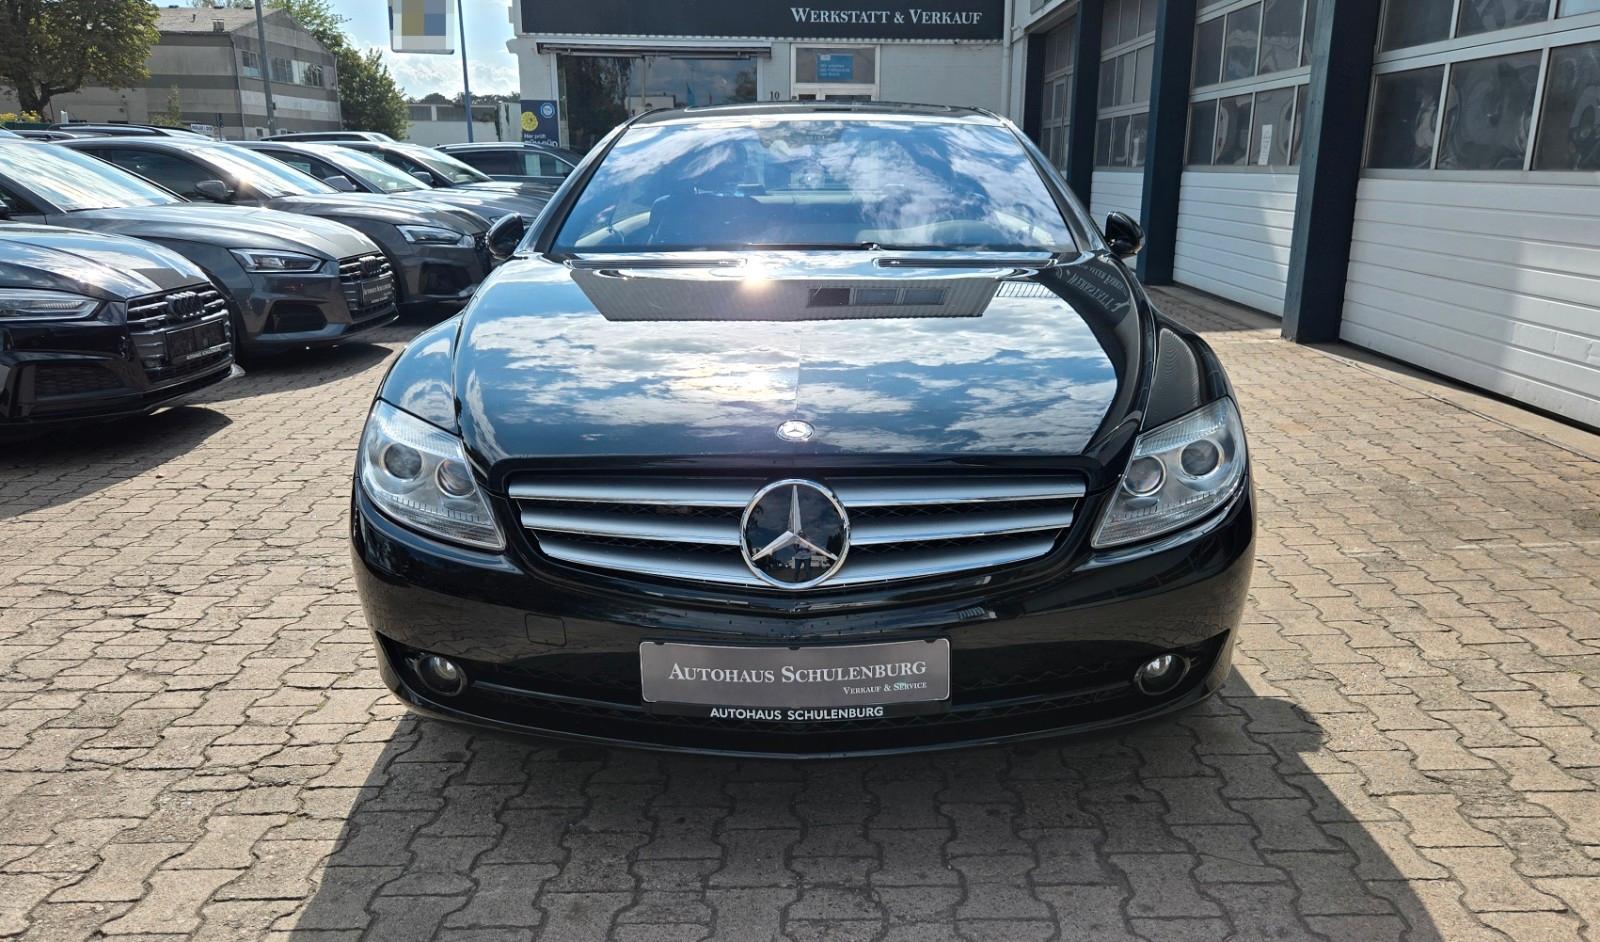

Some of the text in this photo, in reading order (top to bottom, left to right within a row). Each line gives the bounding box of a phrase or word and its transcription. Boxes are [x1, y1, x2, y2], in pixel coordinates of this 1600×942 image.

[790, 7, 983, 25] WERKSTATT & VERKAUF
[770, 91, 780, 101] 10
[668, 661, 927, 683] AUTOHAUS SCHULENBURG
[843, 682, 927, 695] VERKAUF & SERVICE
[710, 706, 884, 720] AUTOHAUS SCHULENBURG
